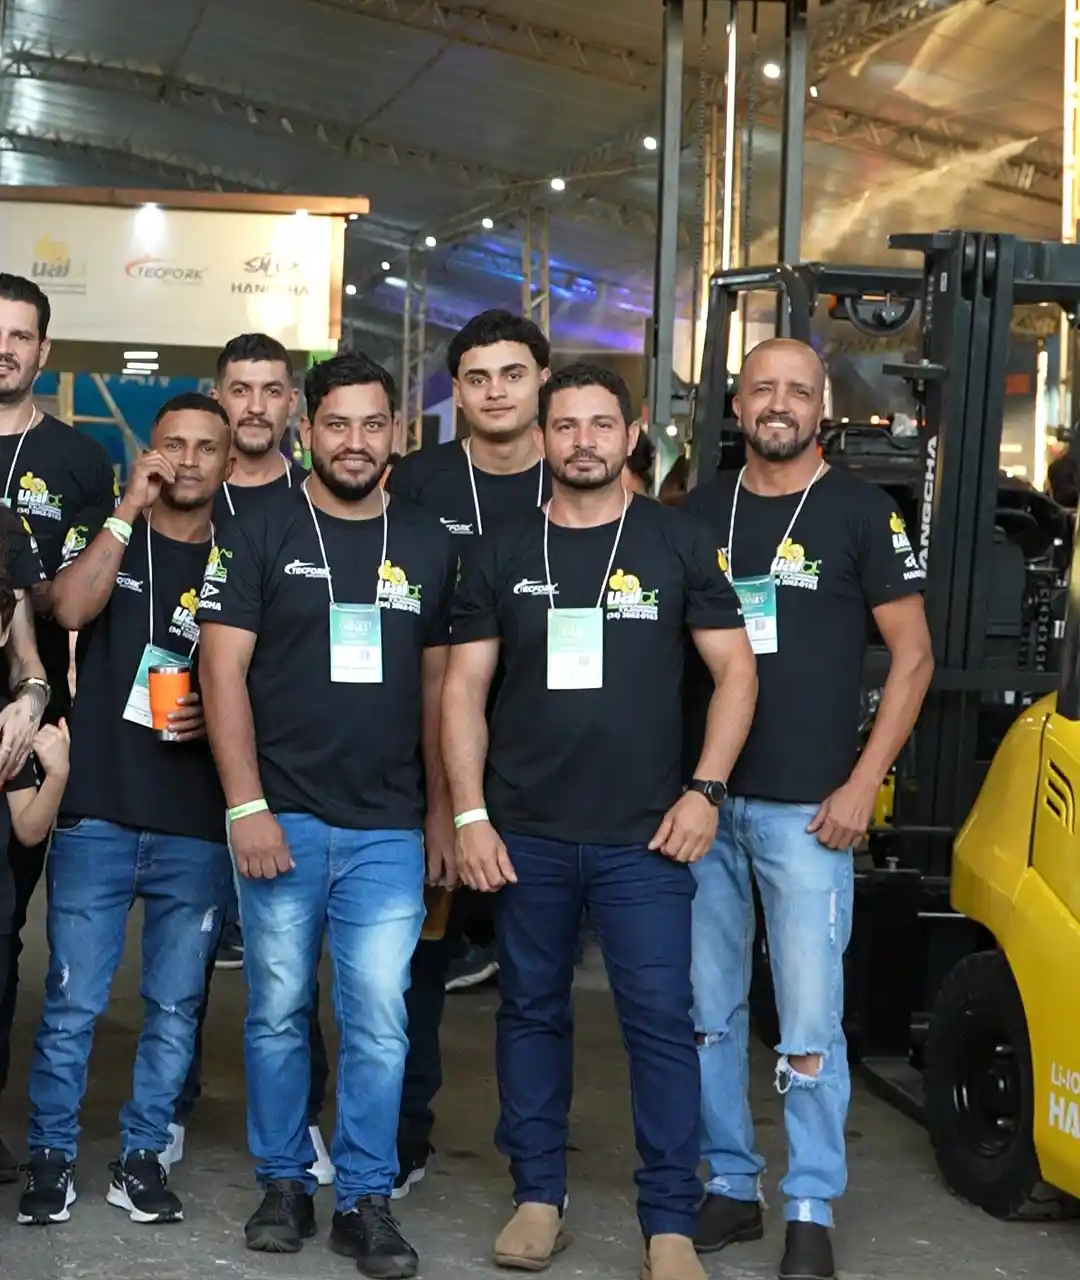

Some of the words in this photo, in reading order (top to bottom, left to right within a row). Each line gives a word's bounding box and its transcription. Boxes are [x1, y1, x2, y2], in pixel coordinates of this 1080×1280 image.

[127, 263, 206, 280] TECFORK
[230, 281, 310, 297] HANHA
[919, 435, 938, 572] ANGCHA
